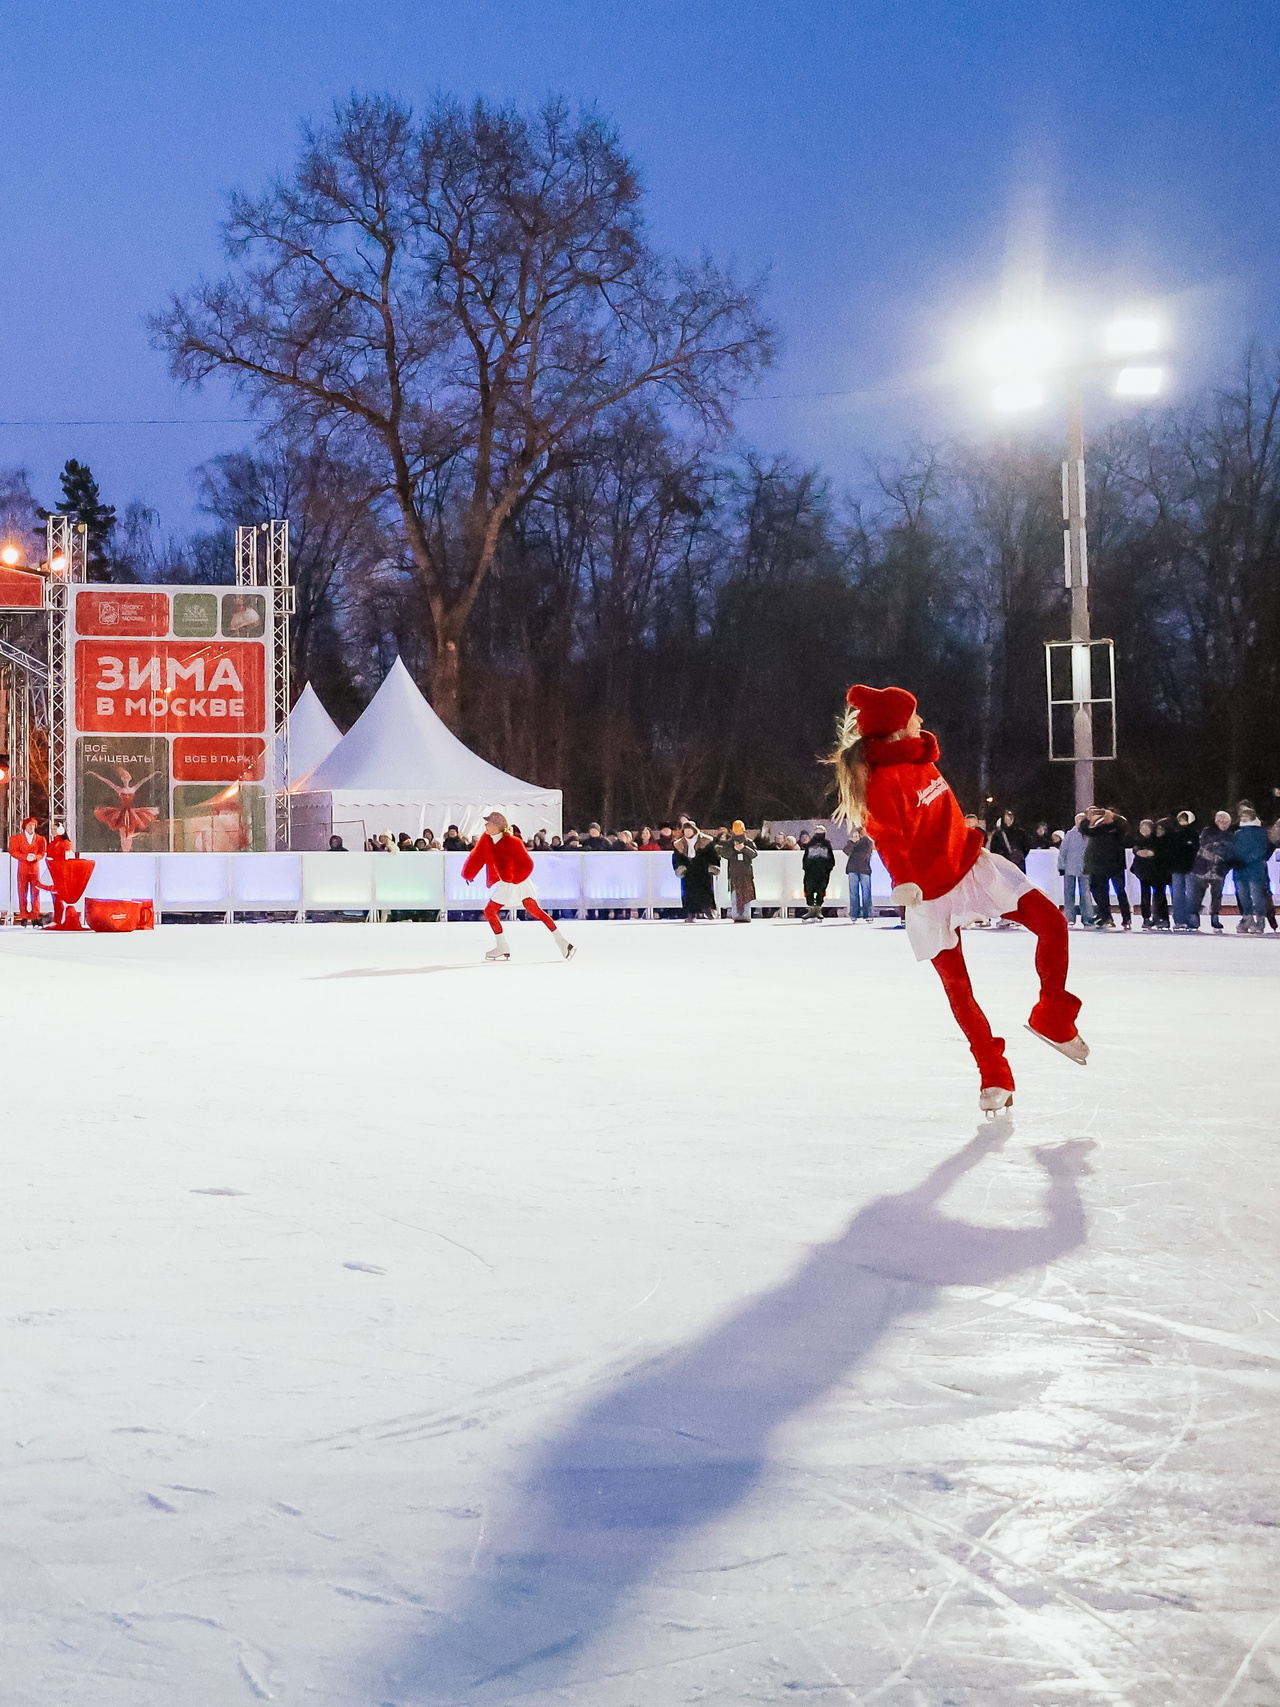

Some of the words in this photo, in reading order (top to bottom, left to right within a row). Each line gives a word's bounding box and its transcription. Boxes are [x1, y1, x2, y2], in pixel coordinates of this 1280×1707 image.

[95, 656, 244, 692] ЗИМА
[96, 698, 115, 716] В
[125, 698, 245, 717] МОСКВЕ
[84, 744, 108, 753] ВСЕ
[184, 755, 207, 764] ВСЕ
[210, 755, 218, 764] В
